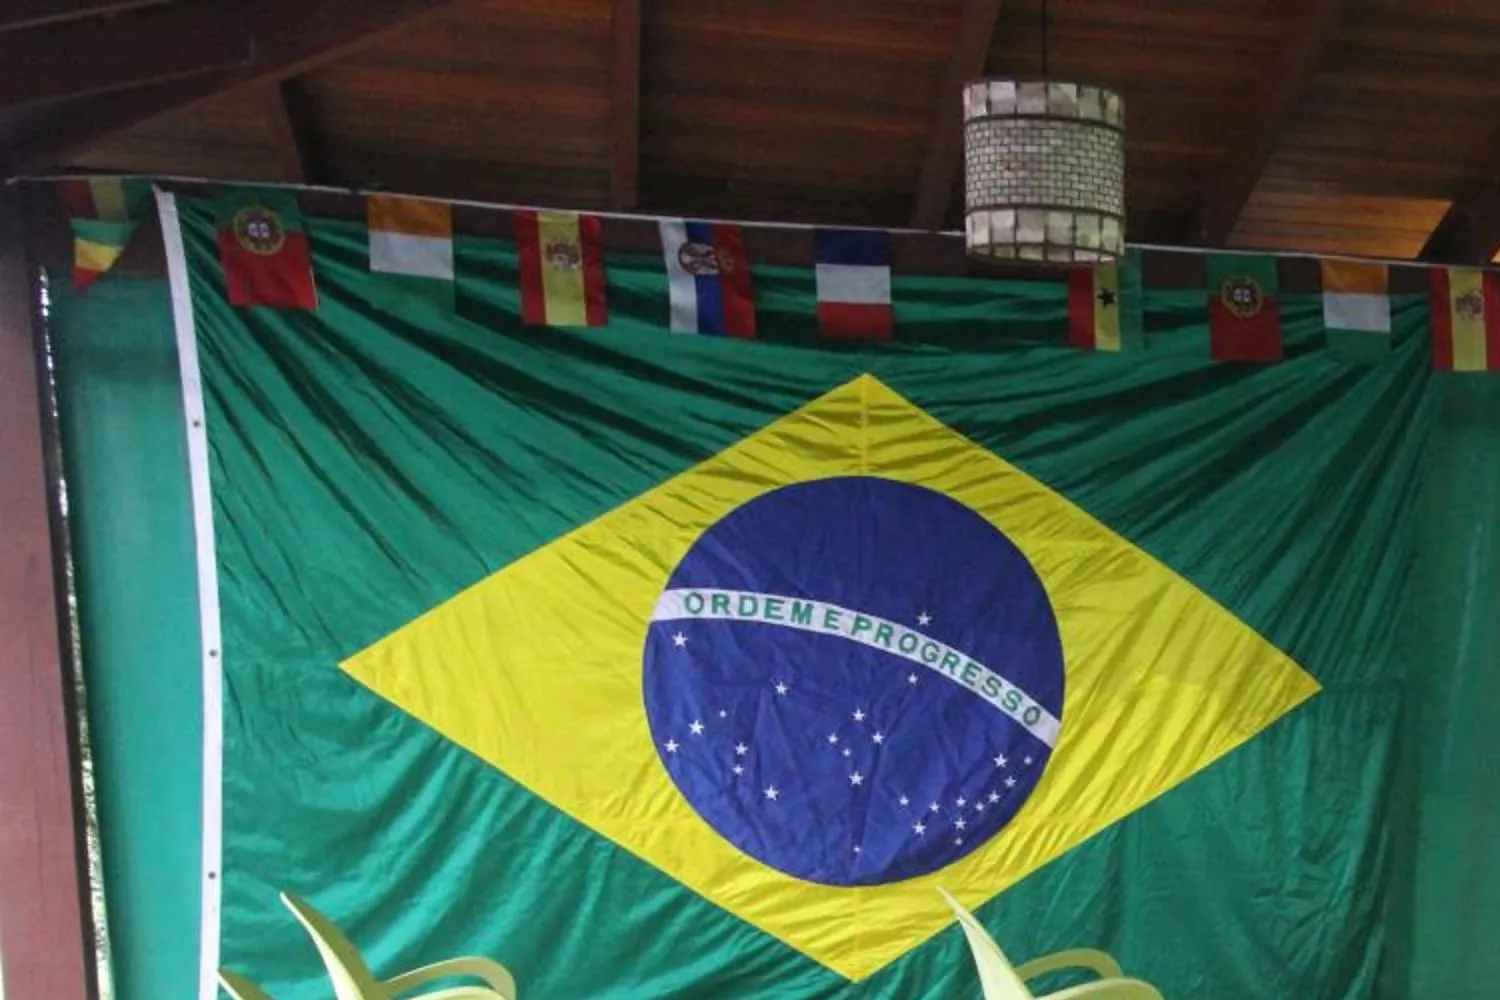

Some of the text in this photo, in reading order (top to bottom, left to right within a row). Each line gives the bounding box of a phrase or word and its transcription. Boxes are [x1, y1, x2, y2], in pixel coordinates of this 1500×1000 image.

[684, 592, 1042, 728] ORDEM E PROGRESSO
